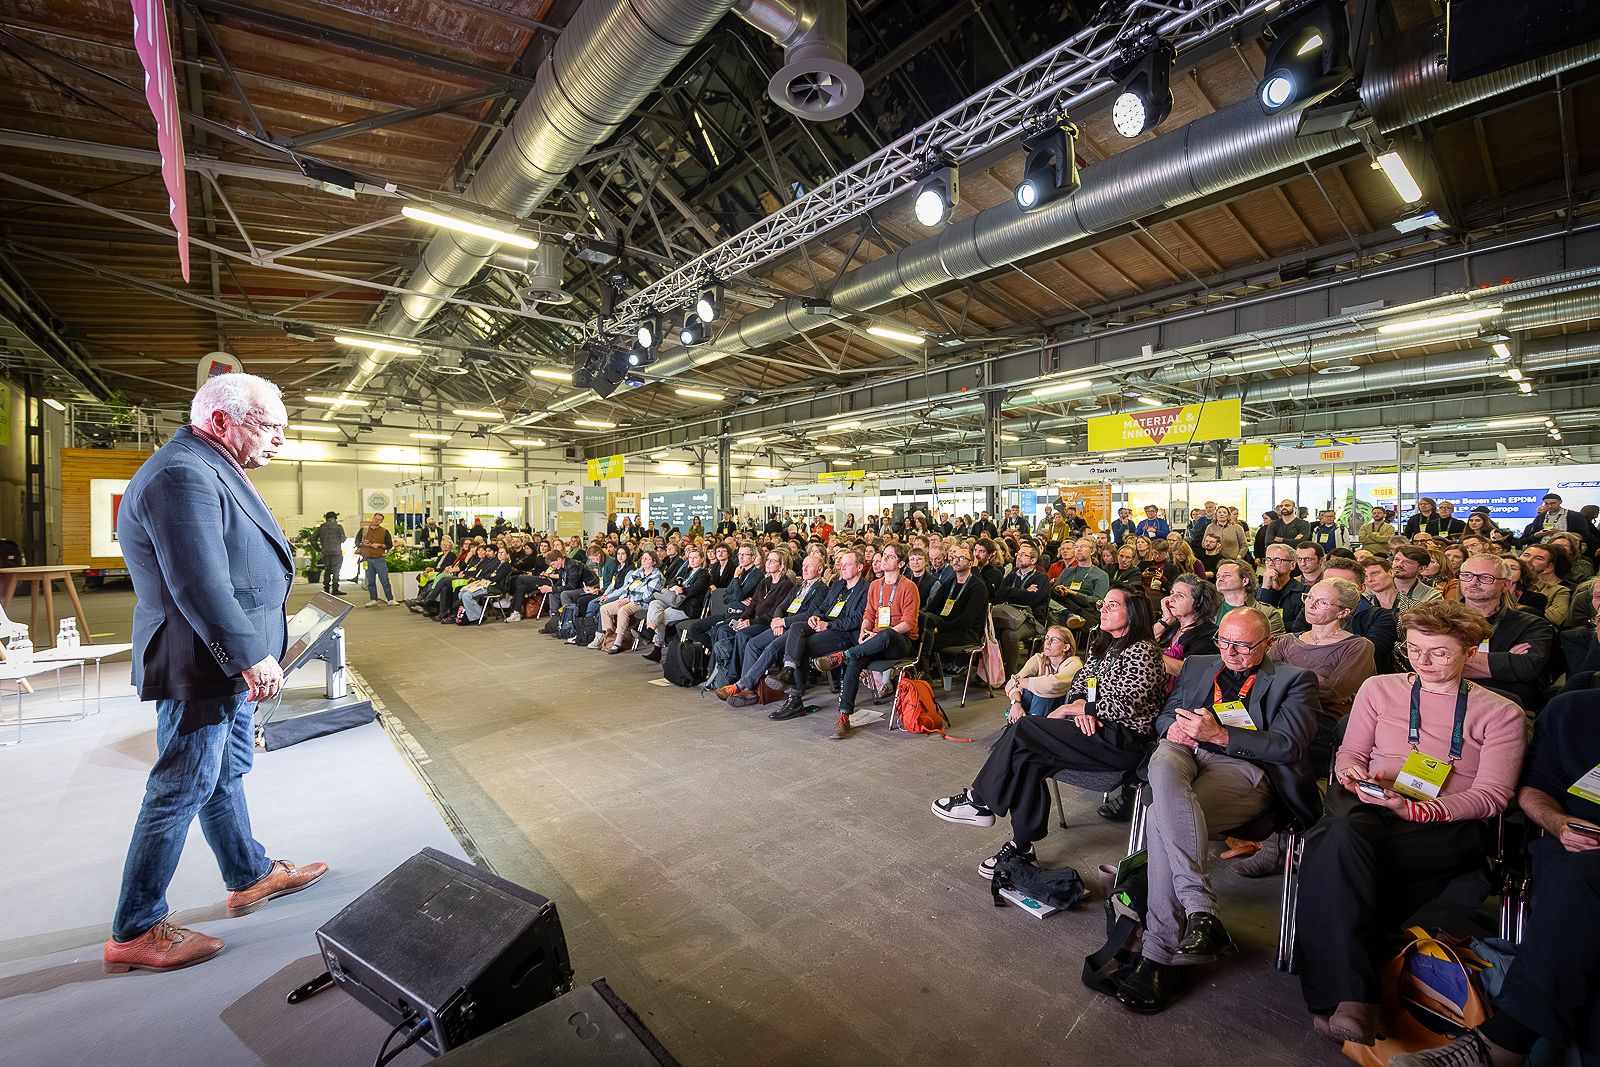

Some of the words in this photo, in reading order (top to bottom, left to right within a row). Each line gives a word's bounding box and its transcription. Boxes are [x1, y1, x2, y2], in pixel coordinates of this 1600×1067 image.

[1123, 414, 1182, 429] MATERIAL
[1186, 412, 1195, 422] &
[1121, 423, 1196, 440] INNOVATION
[1323, 451, 1341, 459] TIGER
[1462, 497, 1490, 505] Bauen
[1508, 496, 1537, 504] EPDM
[1490, 505, 1520, 513] Europe
